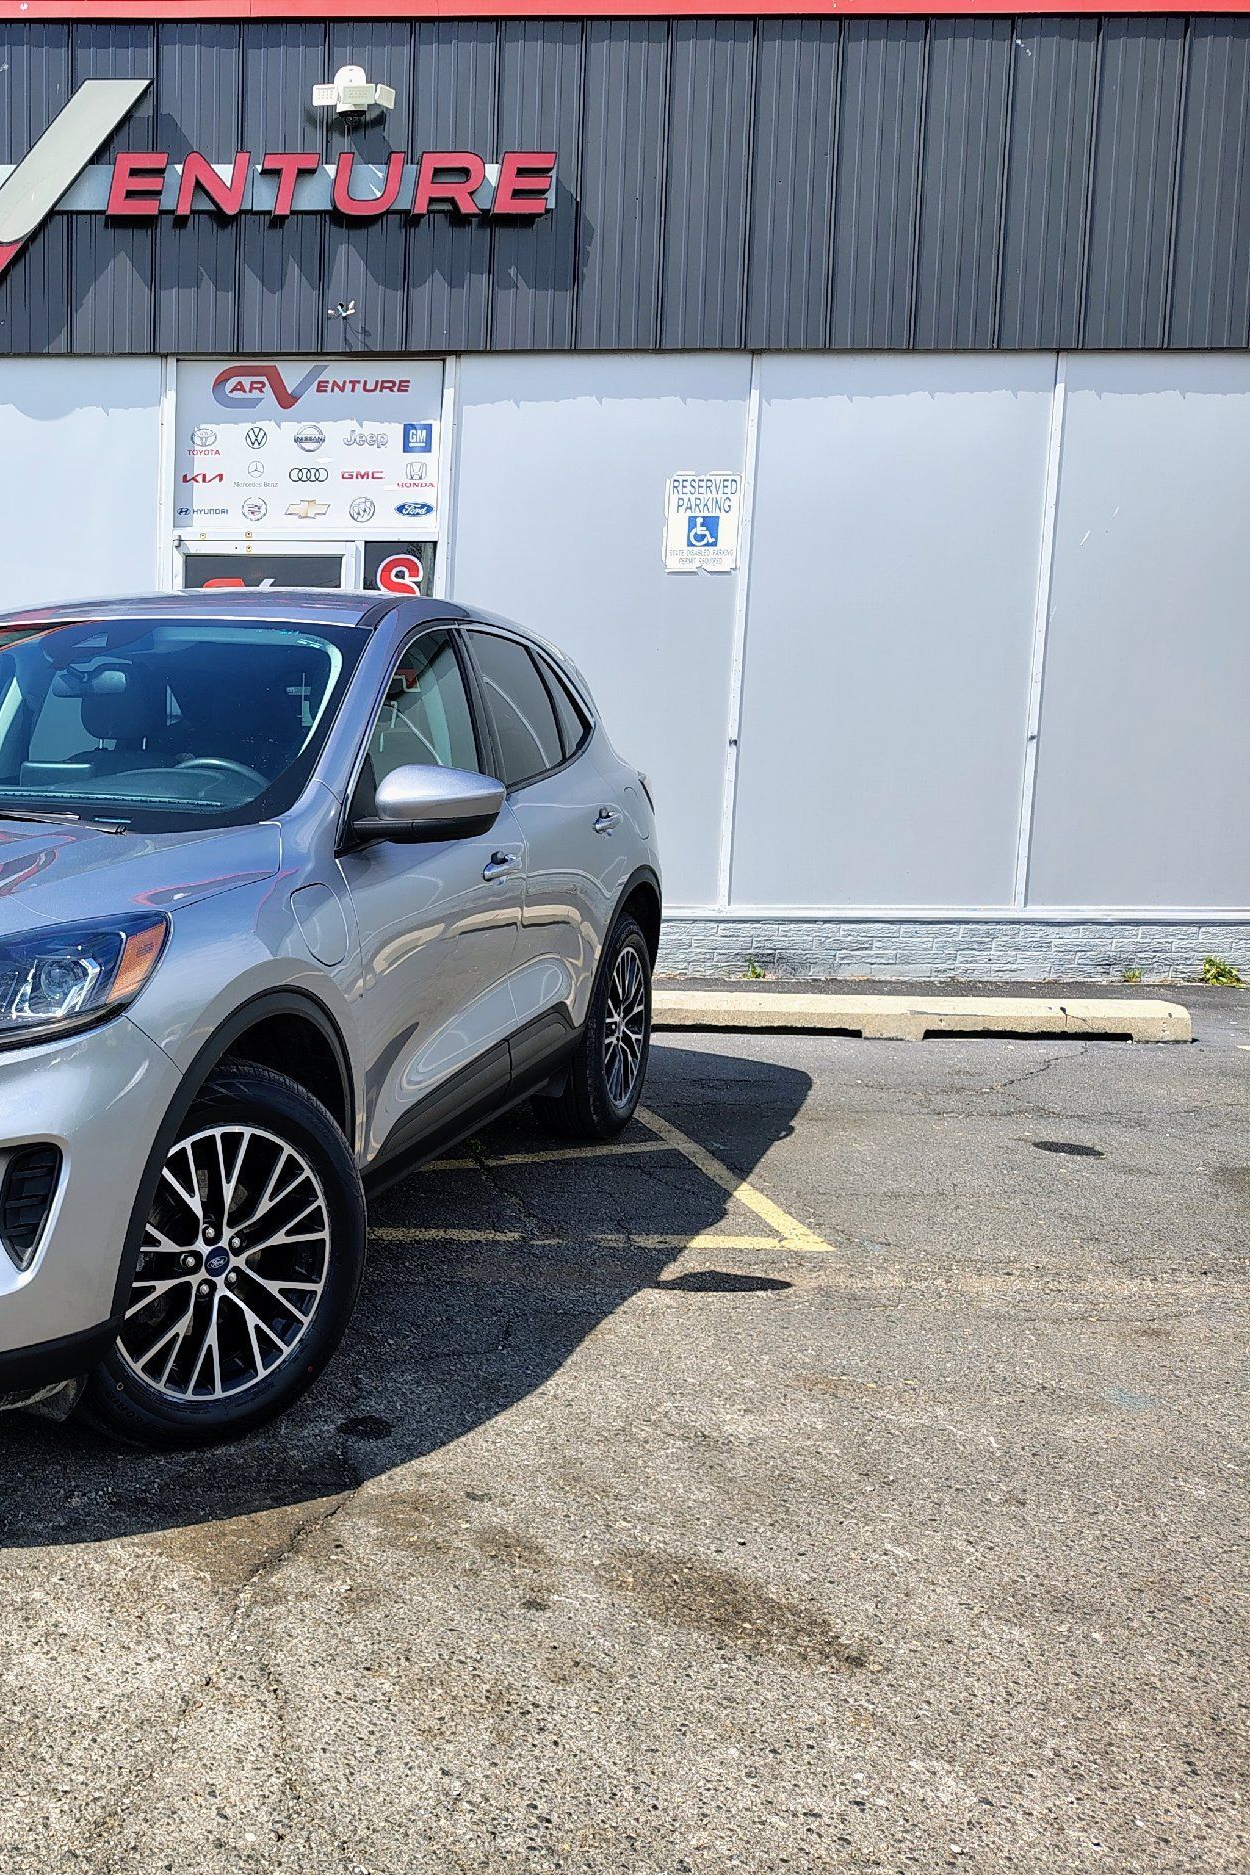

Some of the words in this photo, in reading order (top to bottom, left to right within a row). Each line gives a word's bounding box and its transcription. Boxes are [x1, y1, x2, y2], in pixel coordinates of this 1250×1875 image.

[343, 430, 388, 448] Jeep
[410, 430, 427, 443] GM
[182, 473, 224, 483] KIA
[341, 471, 384, 480] GMC
[672, 479, 738, 495] RESERVED
[676, 497, 731, 513] PARKING
